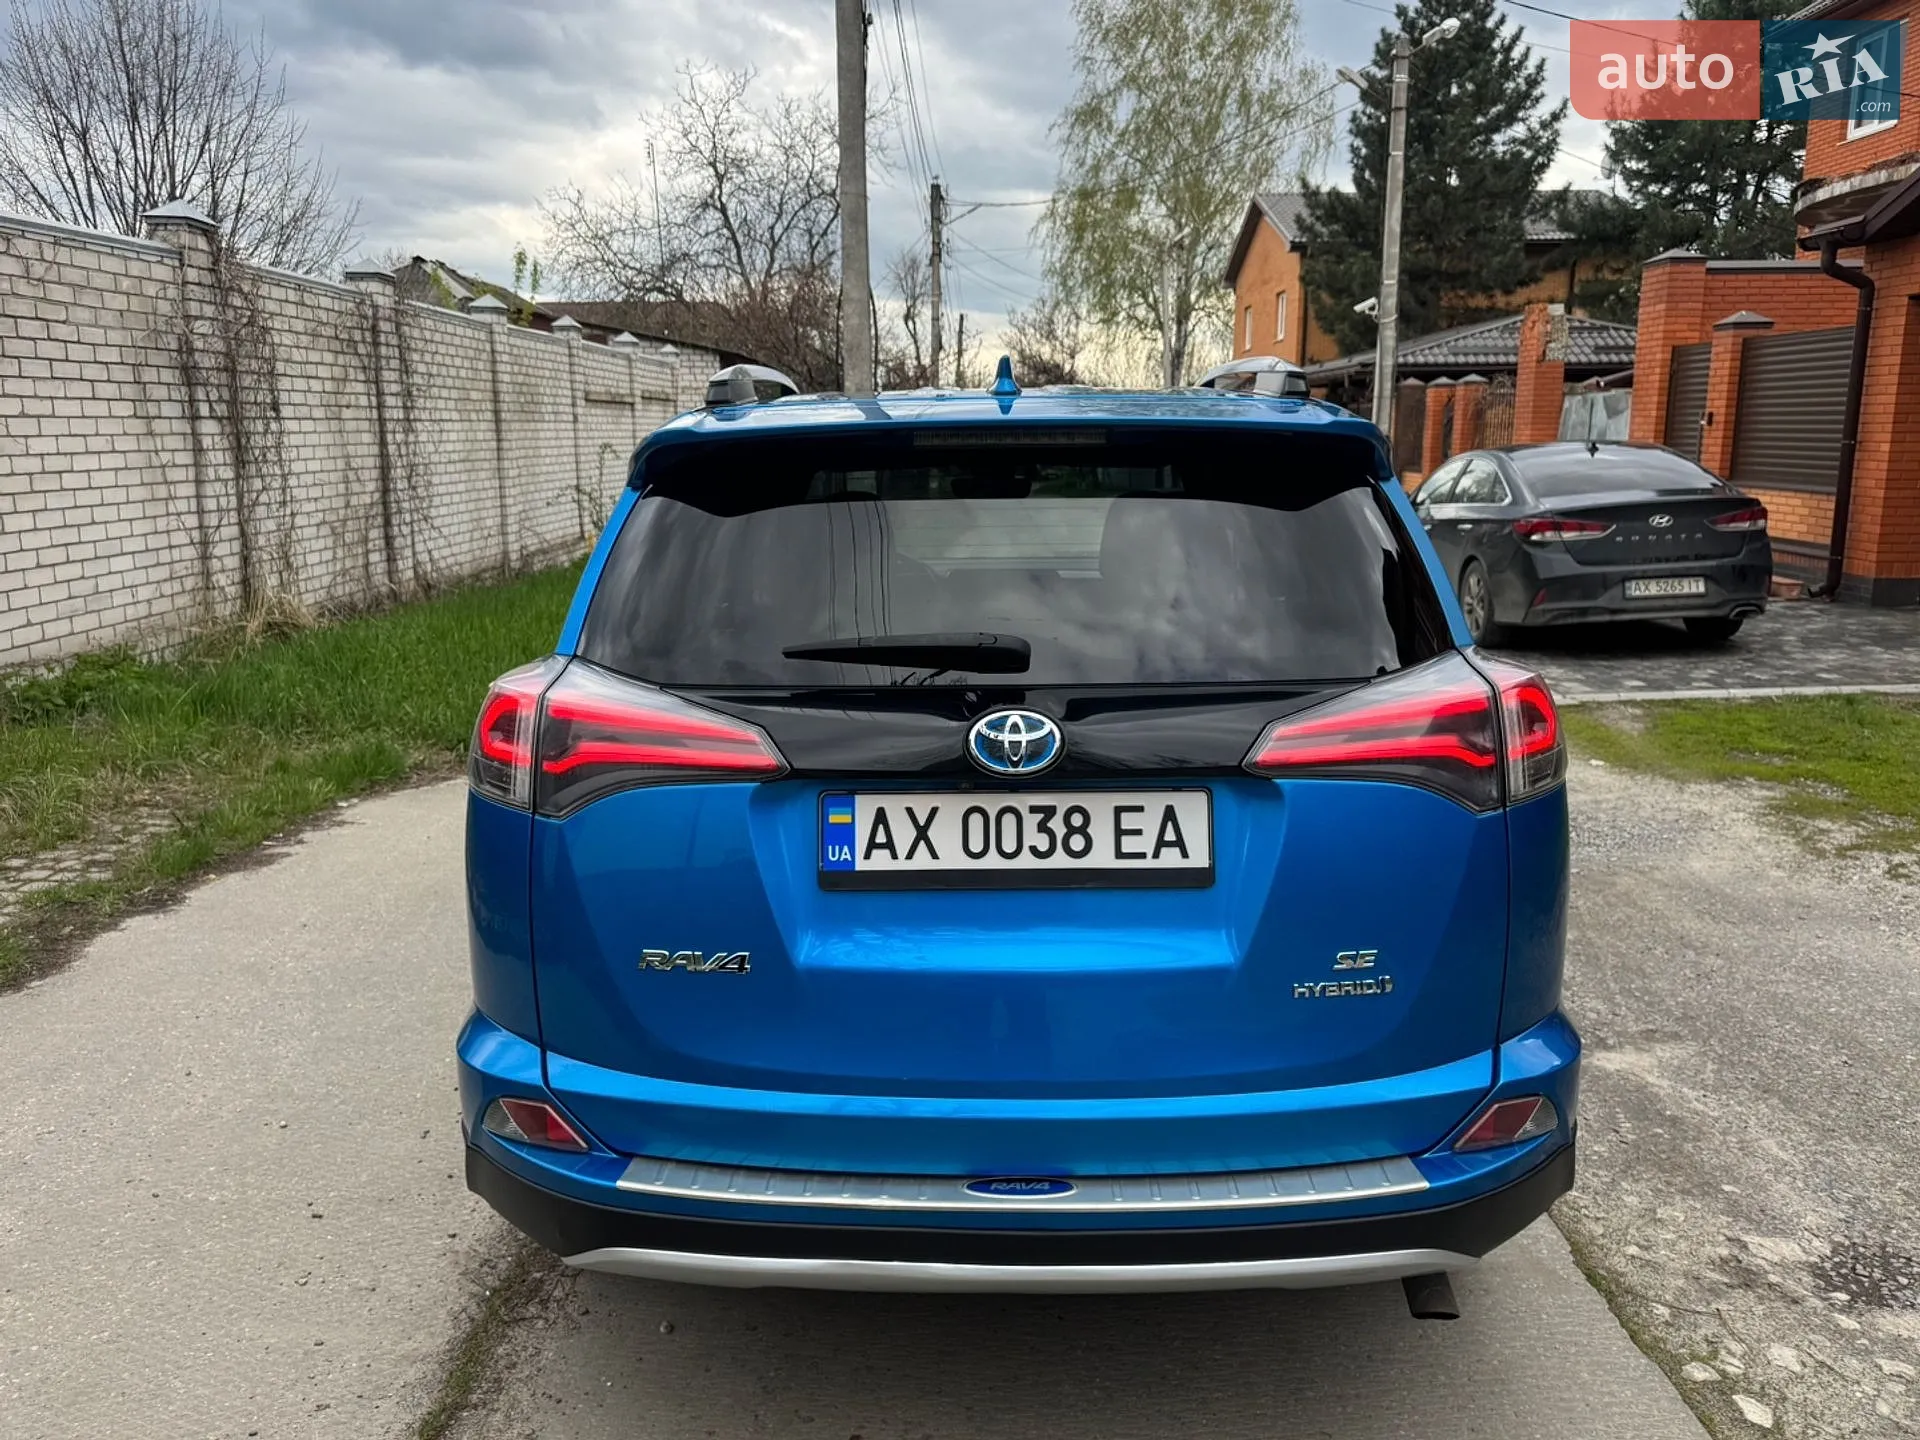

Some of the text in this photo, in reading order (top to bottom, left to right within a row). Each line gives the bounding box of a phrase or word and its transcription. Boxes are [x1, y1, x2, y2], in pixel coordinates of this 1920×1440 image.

[1634, 582, 1651, 593] AX
[1656, 580, 1684, 592] 5265
[863, 803, 1190, 860] AX 0038 EA
[828, 845, 852, 861] UA
[638, 948, 751, 975] RAV4
[1332, 949, 1379, 970] SE
[1293, 979, 1379, 999] HYBRID
[989, 1181, 1051, 1191] RAV4
